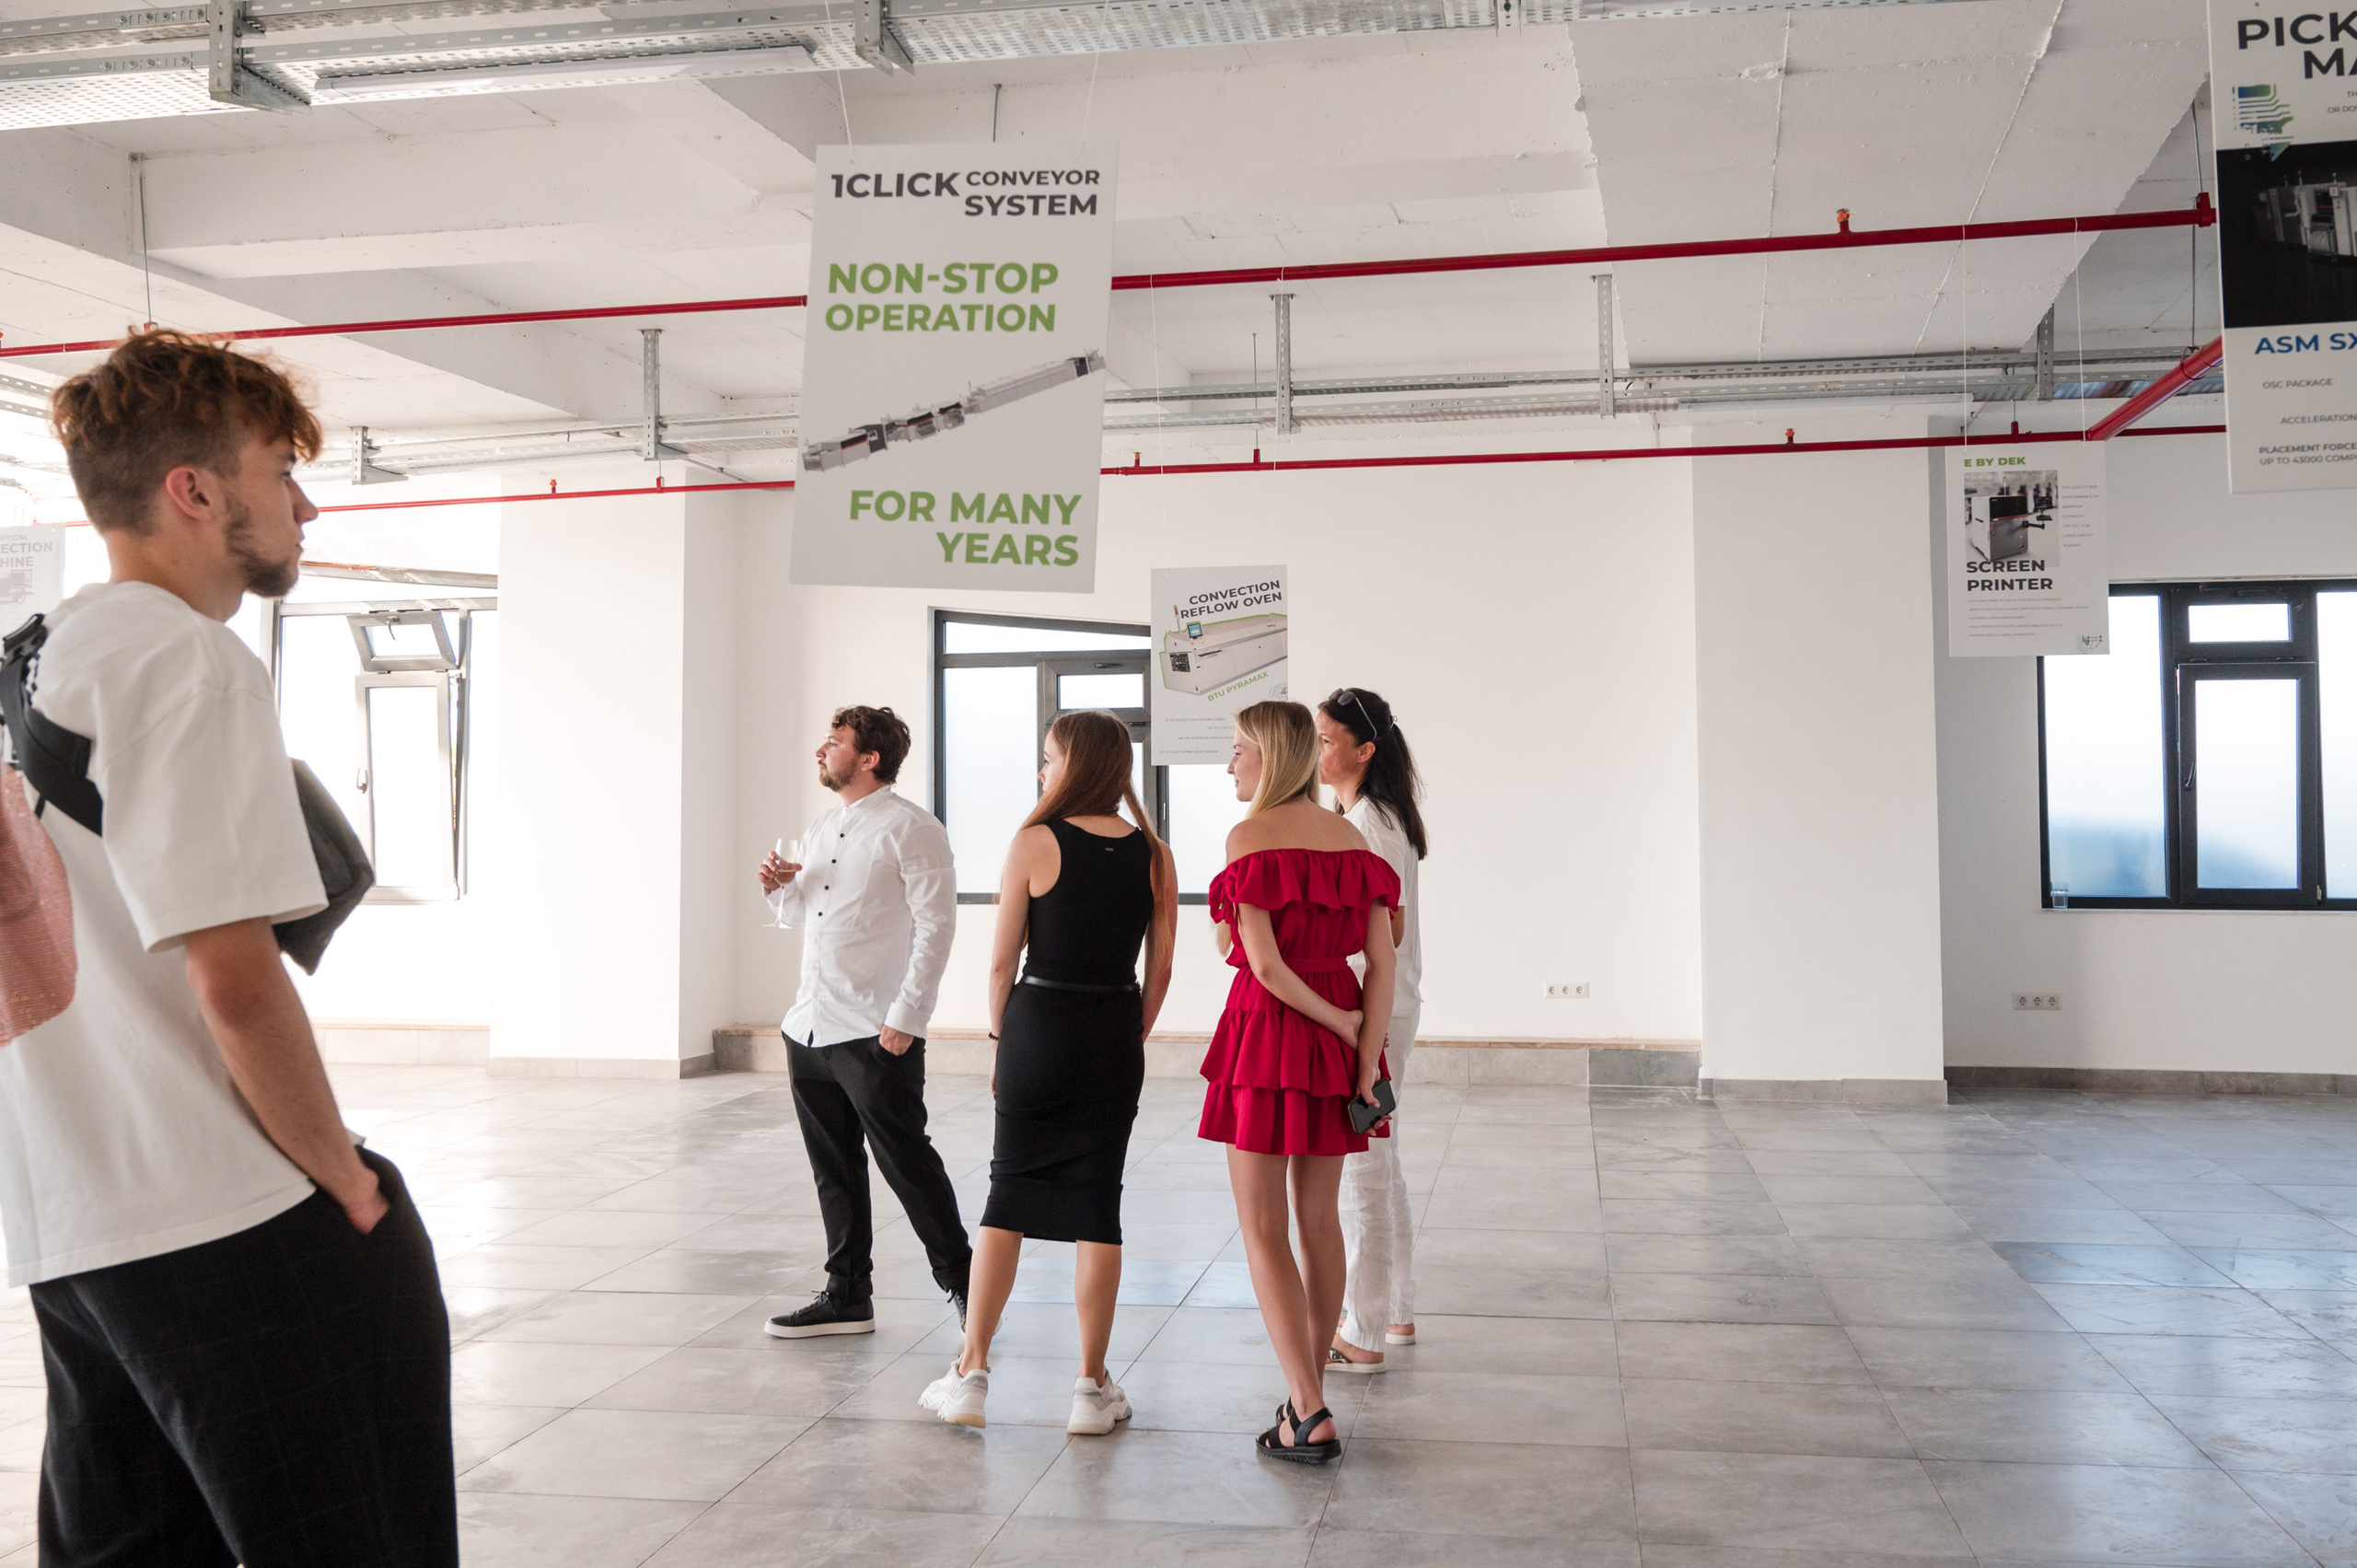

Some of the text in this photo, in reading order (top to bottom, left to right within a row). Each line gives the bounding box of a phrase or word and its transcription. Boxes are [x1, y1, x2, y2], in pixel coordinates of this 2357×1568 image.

[2237, 10, 2357, 50] PICK
[2304, 48, 2357, 79] M
[831, 170, 1100, 198] 1CLICK CONVEYOR
[965, 194, 1097, 216] SYSTEM
[829, 262, 1059, 294] NON-STOP
[825, 304, 1056, 331] OPERATION
[2255, 334, 2319, 354] ASM
[2286, 378, 2333, 388] PACKAGE
[2281, 413, 2357, 424] ACCELERATION
[2259, 442, 2357, 454] PLACEMENT FORCE
[1976, 458, 1994, 467] BY
[1998, 457, 2026, 466] DEK
[2276, 457, 2291, 465] TO
[2326, 454, 2357, 462] COMP
[850, 491, 1082, 525] FOR MANY
[1, 541, 53, 554] ECTION
[935, 532, 1079, 566] YEARS
[0, 556, 34, 568] HINE
[1967, 560, 2045, 573] SCREEN
[1189, 580, 1281, 605] CONVECTION
[1968, 578, 2053, 591] PRINTER
[1180, 592, 1283, 619] REFLOW OVEN
[1208, 670, 1269, 702] BTU PYRAMAX
